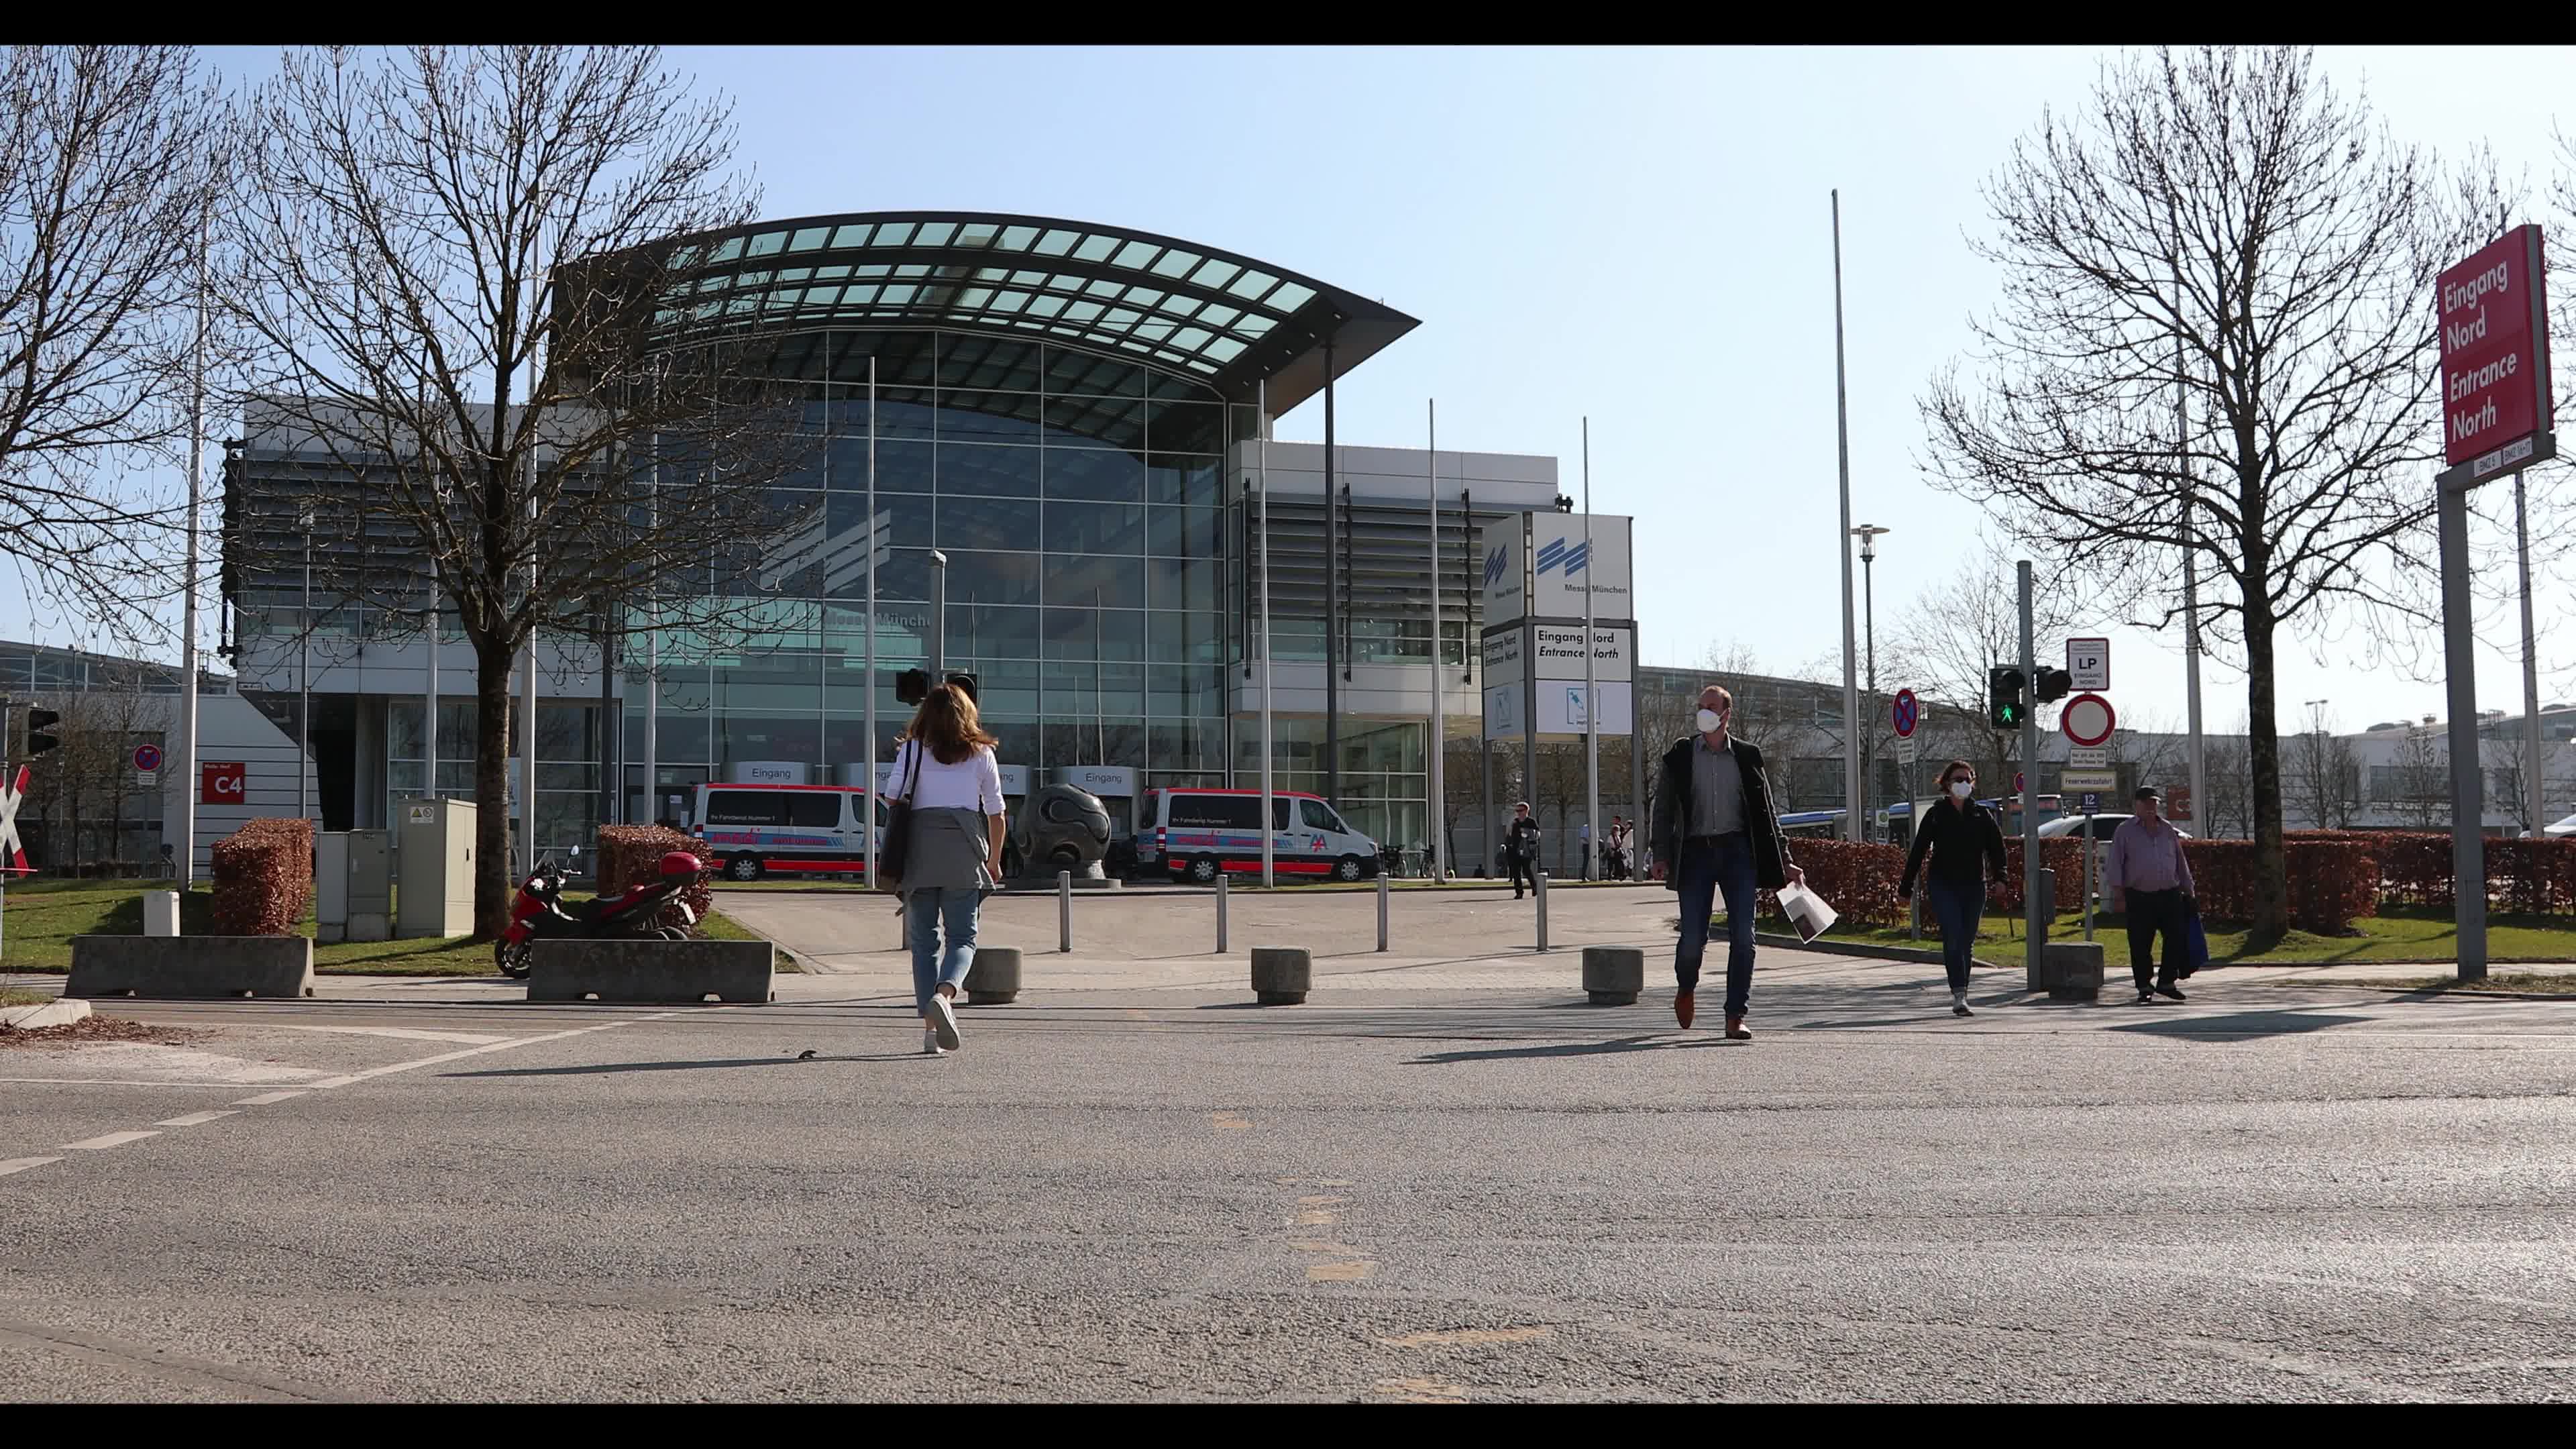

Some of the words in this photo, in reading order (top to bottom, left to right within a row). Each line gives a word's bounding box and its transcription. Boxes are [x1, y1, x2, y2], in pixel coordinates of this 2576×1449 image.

[2444, 260, 2508, 315] Eingang
[2447, 304, 2486, 354] Nord
[2450, 352, 2517, 403] Entrance
[2452, 395, 2496, 443] North
[1592, 585, 1627, 594] München
[1538, 631, 1583, 644] Eingang
[1540, 646, 1585, 657] Entrance
[2079, 658, 2097, 669] LP
[752, 768, 791, 780] Eingang
[1085, 773, 1122, 784] Eingang
[215, 776, 242, 794] C4
[2084, 794, 2095, 805] 12
